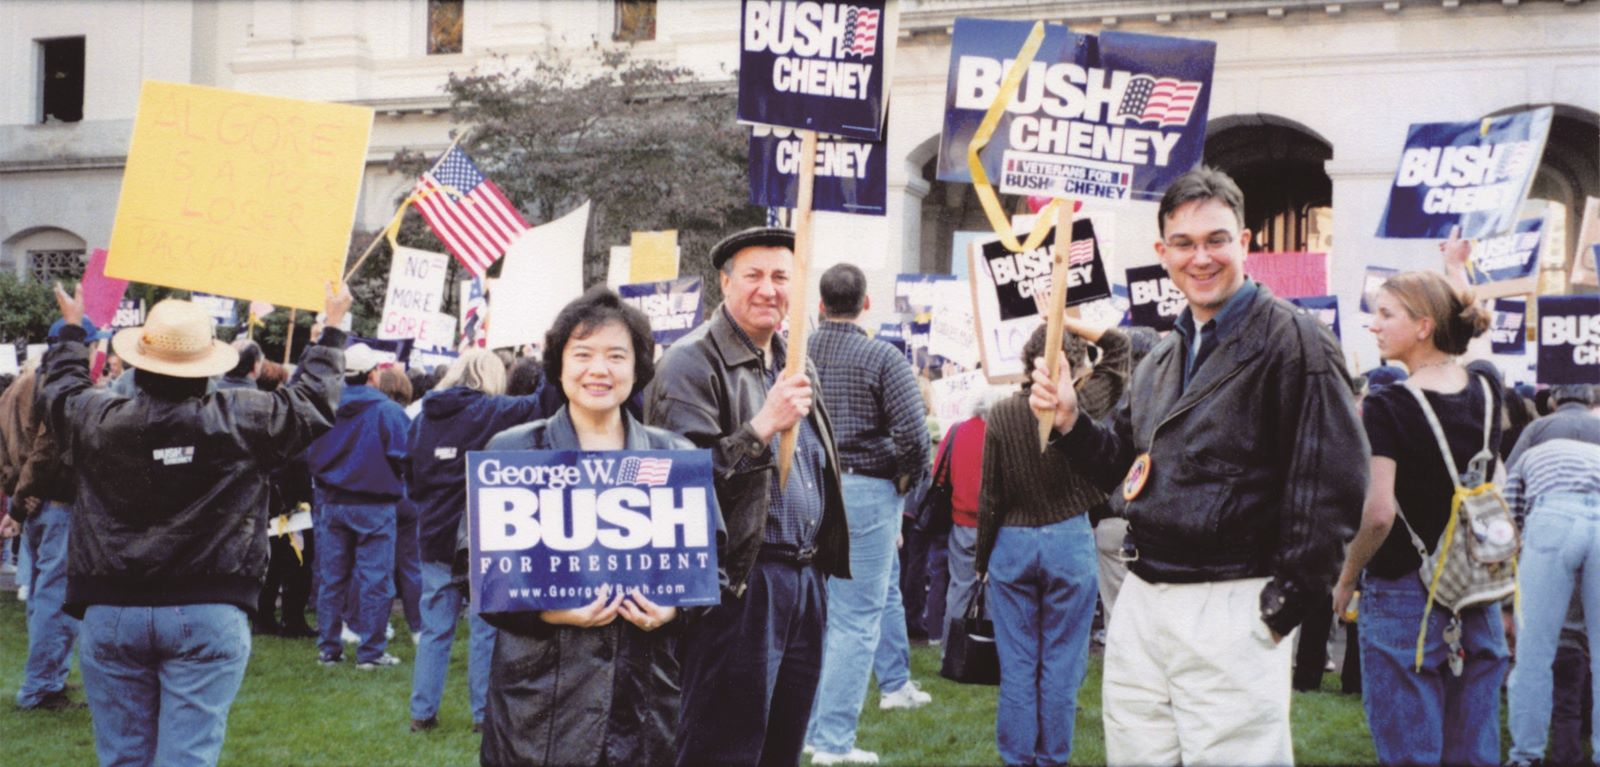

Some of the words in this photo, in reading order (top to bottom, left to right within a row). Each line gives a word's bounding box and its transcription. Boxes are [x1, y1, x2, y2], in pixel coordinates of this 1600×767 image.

[744, 0, 848, 59] BUSH
[773, 56, 873, 100] CHENEY
[955, 55, 1133, 125] BUSH
[154, 92, 206, 142] AL
[217, 101, 344, 157] GORE
[1009, 116, 1182, 167] CHENEY
[776, 140, 873, 179] CHENEY
[1021, 160, 1087, 180] VETERANS
[1088, 168, 1113, 184] FOR
[1397, 143, 1504, 187] BUSH
[1005, 174, 1049, 190] BUSH
[1064, 179, 1127, 200] CHENEY
[405, 256, 429, 280] NO
[1017, 265, 1093, 299] CHEEY
[392, 287, 434, 313] MORE
[1130, 277, 1187, 306] BUS
[112, 308, 140, 327] USH
[384, 311, 428, 341] GORE
[1541, 315, 1600, 346] BUS
[477, 459, 581, 489] George
[582, 458, 615, 485] W.
[478, 487, 709, 551] BUSH
[480, 556, 533, 574] FOR
[550, 553, 709, 573] PRESIDENT
